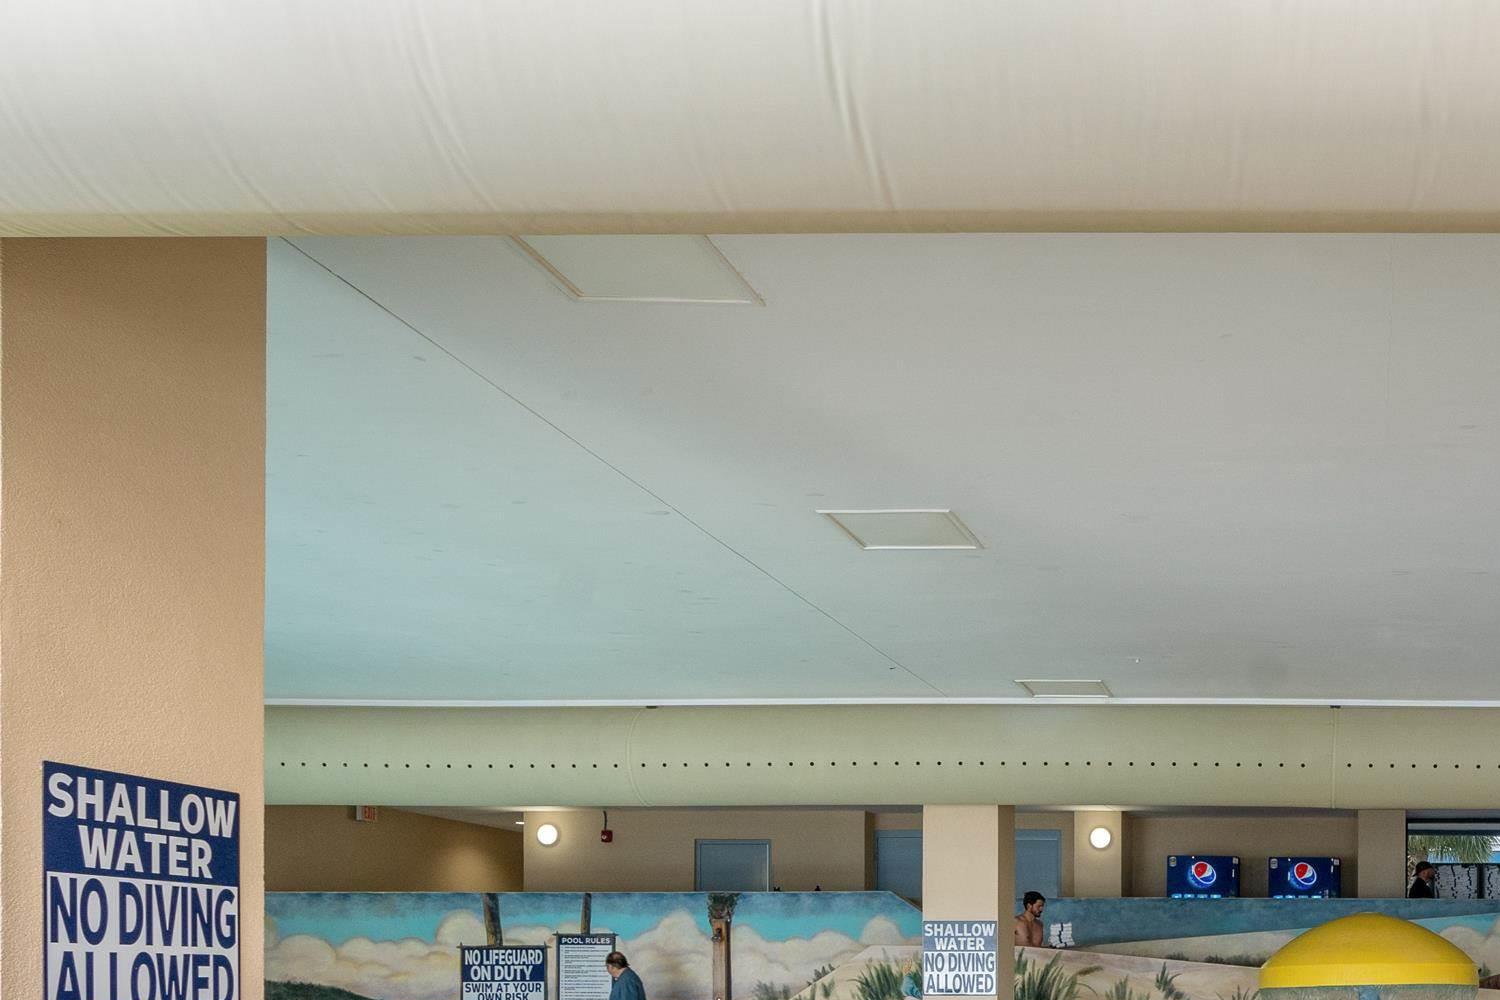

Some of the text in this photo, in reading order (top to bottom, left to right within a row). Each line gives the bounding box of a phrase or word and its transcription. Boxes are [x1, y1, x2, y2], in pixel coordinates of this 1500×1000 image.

[48, 772, 236, 838] SHALLOW
[78, 824, 213, 879] WATER
[50, 876, 236, 949] NO DIVING
[924, 923, 996, 937] SHALLOW
[934, 937, 985, 950] WATER
[465, 949, 543, 965] NO LIFEGUARD
[925, 953, 995, 972] NO DIVING
[470, 966, 533, 981] ON DUTY
[465, 983, 542, 993] SWIM AT YOUR
[925, 973, 994, 993] ALLOWED
